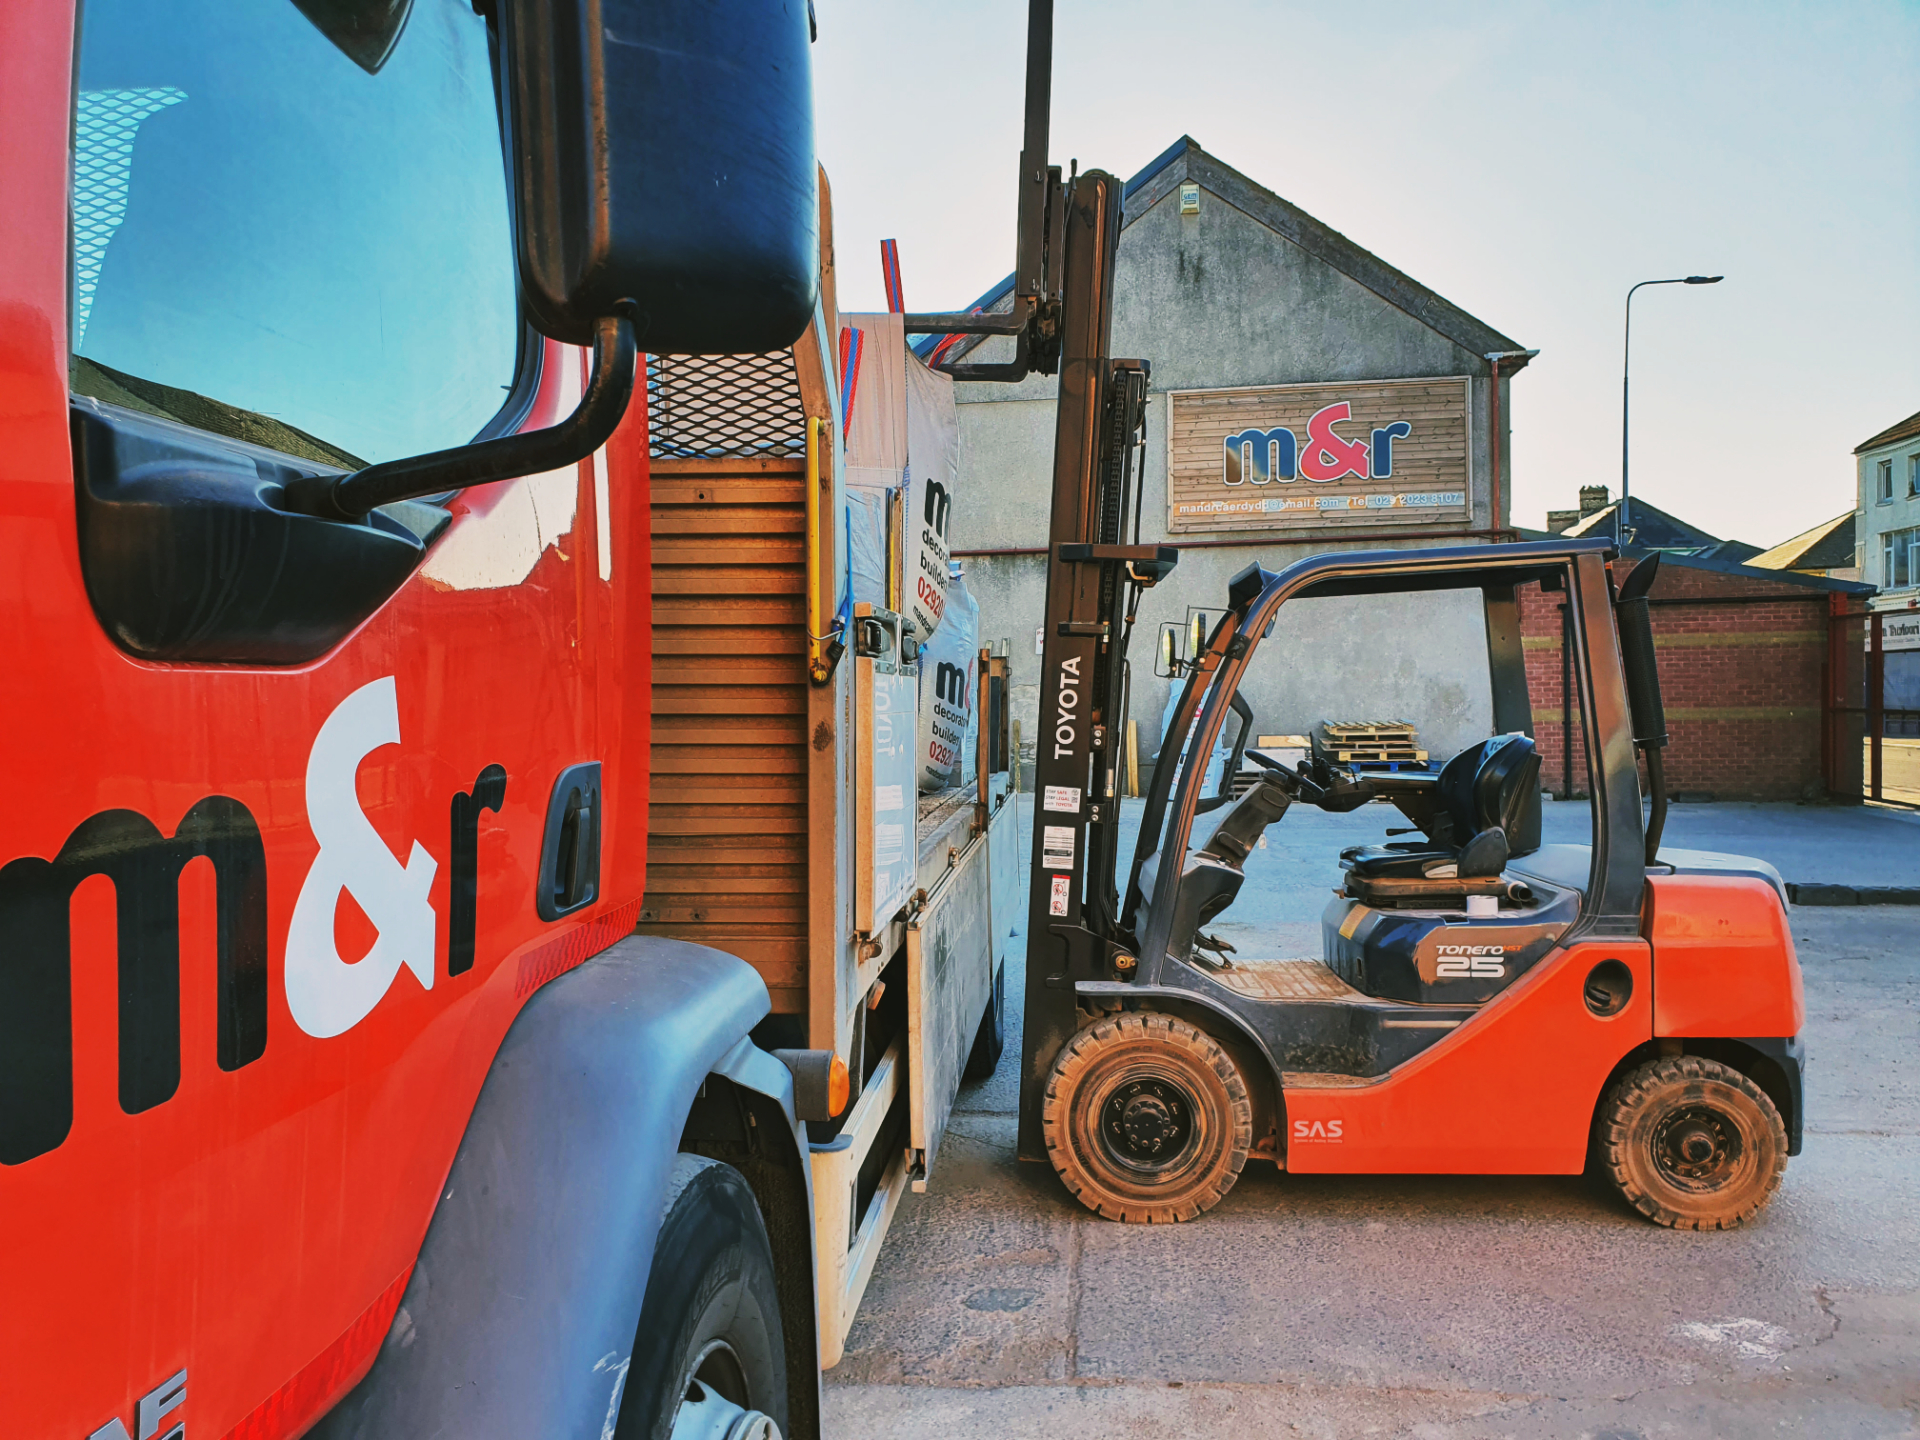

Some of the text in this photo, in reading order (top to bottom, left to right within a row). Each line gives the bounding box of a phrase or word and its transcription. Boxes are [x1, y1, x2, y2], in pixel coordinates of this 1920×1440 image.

[1223, 400, 1412, 486] m&r
[1179, 498, 1339, 513] mandrcaerdydd@email.com
[1375, 496, 1396, 505] 029
[1399, 494, 1428, 504] 2023
[1430, 493, 1459, 503] 8107
[1054, 655, 1082, 760] TOYOTA
[0, 675, 507, 1166] m&r
[1436, 945, 1504, 955] TONERO
[1436, 956, 1505, 978] 25
[1293, 1119, 1343, 1138] SAS
